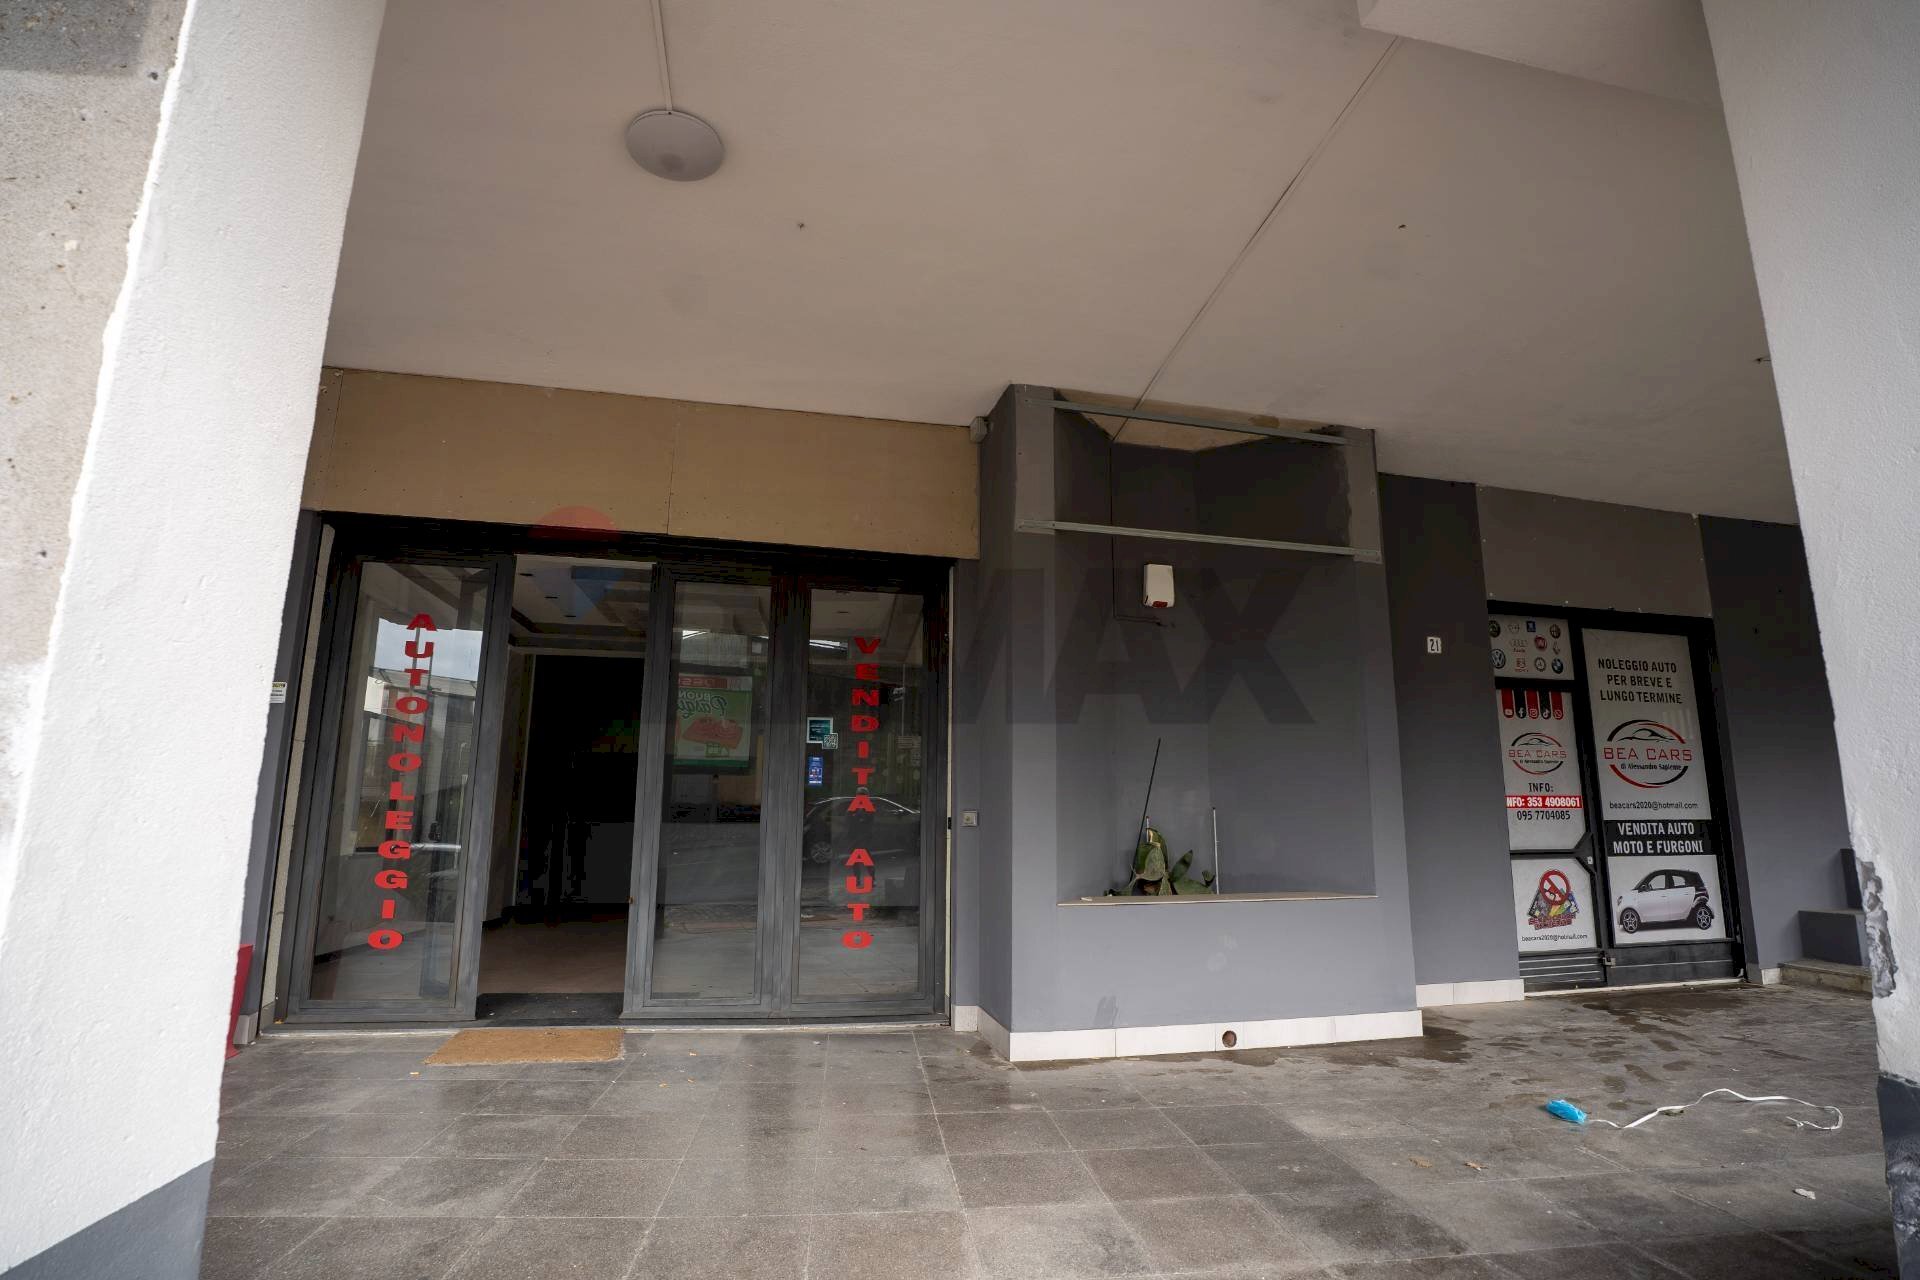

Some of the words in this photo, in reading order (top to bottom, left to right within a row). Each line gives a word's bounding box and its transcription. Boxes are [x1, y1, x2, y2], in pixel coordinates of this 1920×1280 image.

[1429, 638, 1439, 652] 21
[1598, 658, 1649, 672] NOLEGGIO
[1651, 661, 1677, 673] AUTO
[1606, 674, 1627, 686] PER
[1630, 675, 1664, 688] BREVE
[1665, 677, 1673, 688] E
[1600, 689, 1635, 702] LUNGO
[1636, 691, 1683, 704] TERMINE
[847, 636, 881, 813] VENDITA
[1508, 749, 1531, 758] BEA
[1535, 749, 1567, 758] CARS
[1603, 747, 1639, 760] BEA
[1646, 748, 1692, 761] CARS
[368, 613, 437, 951] AUTONOLEGGIO
[1528, 782, 1554, 793] INFO:
[1527, 796, 1543, 807] 353
[1544, 796, 1580, 807] 4908061
[1609, 801, 1699, 811] beacars2020@hotmail.com
[1516, 810, 1533, 821] 095
[1535, 810, 1571, 820] 7704085
[1617, 822, 1666, 836] VENDITA
[1667, 822, 1695, 835] AUTO
[1612, 840, 1644, 854] MOTO
[1646, 840, 1654, 854] E
[1656, 839, 1704, 854] FURGONI
[842, 848, 875, 950] AUTO
